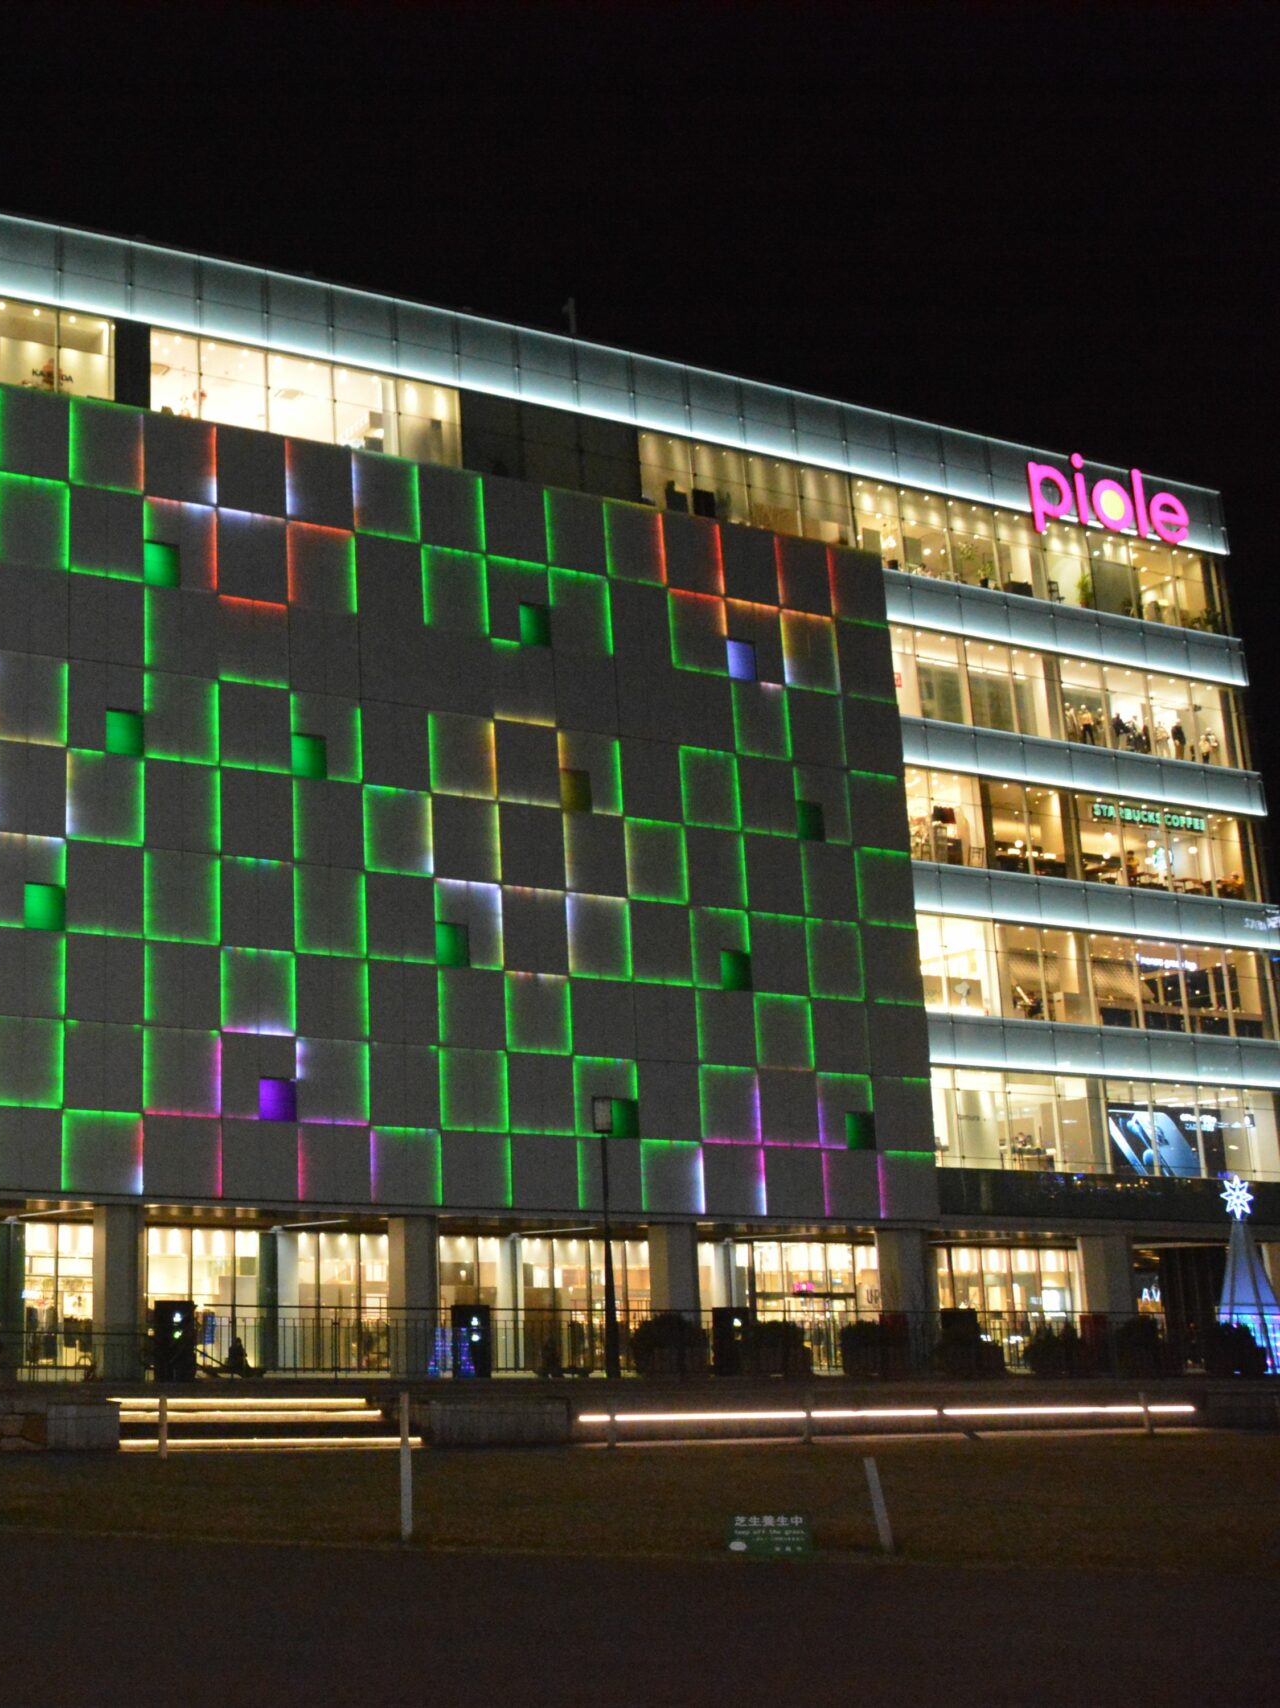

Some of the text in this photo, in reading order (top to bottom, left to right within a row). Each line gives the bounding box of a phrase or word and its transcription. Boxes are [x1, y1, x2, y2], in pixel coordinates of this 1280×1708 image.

[1027, 452, 1190, 544] piole
[1093, 803, 1206, 831] STARBUCKS COFFEE
[734, 1515, 804, 1527] 芝生養生中
